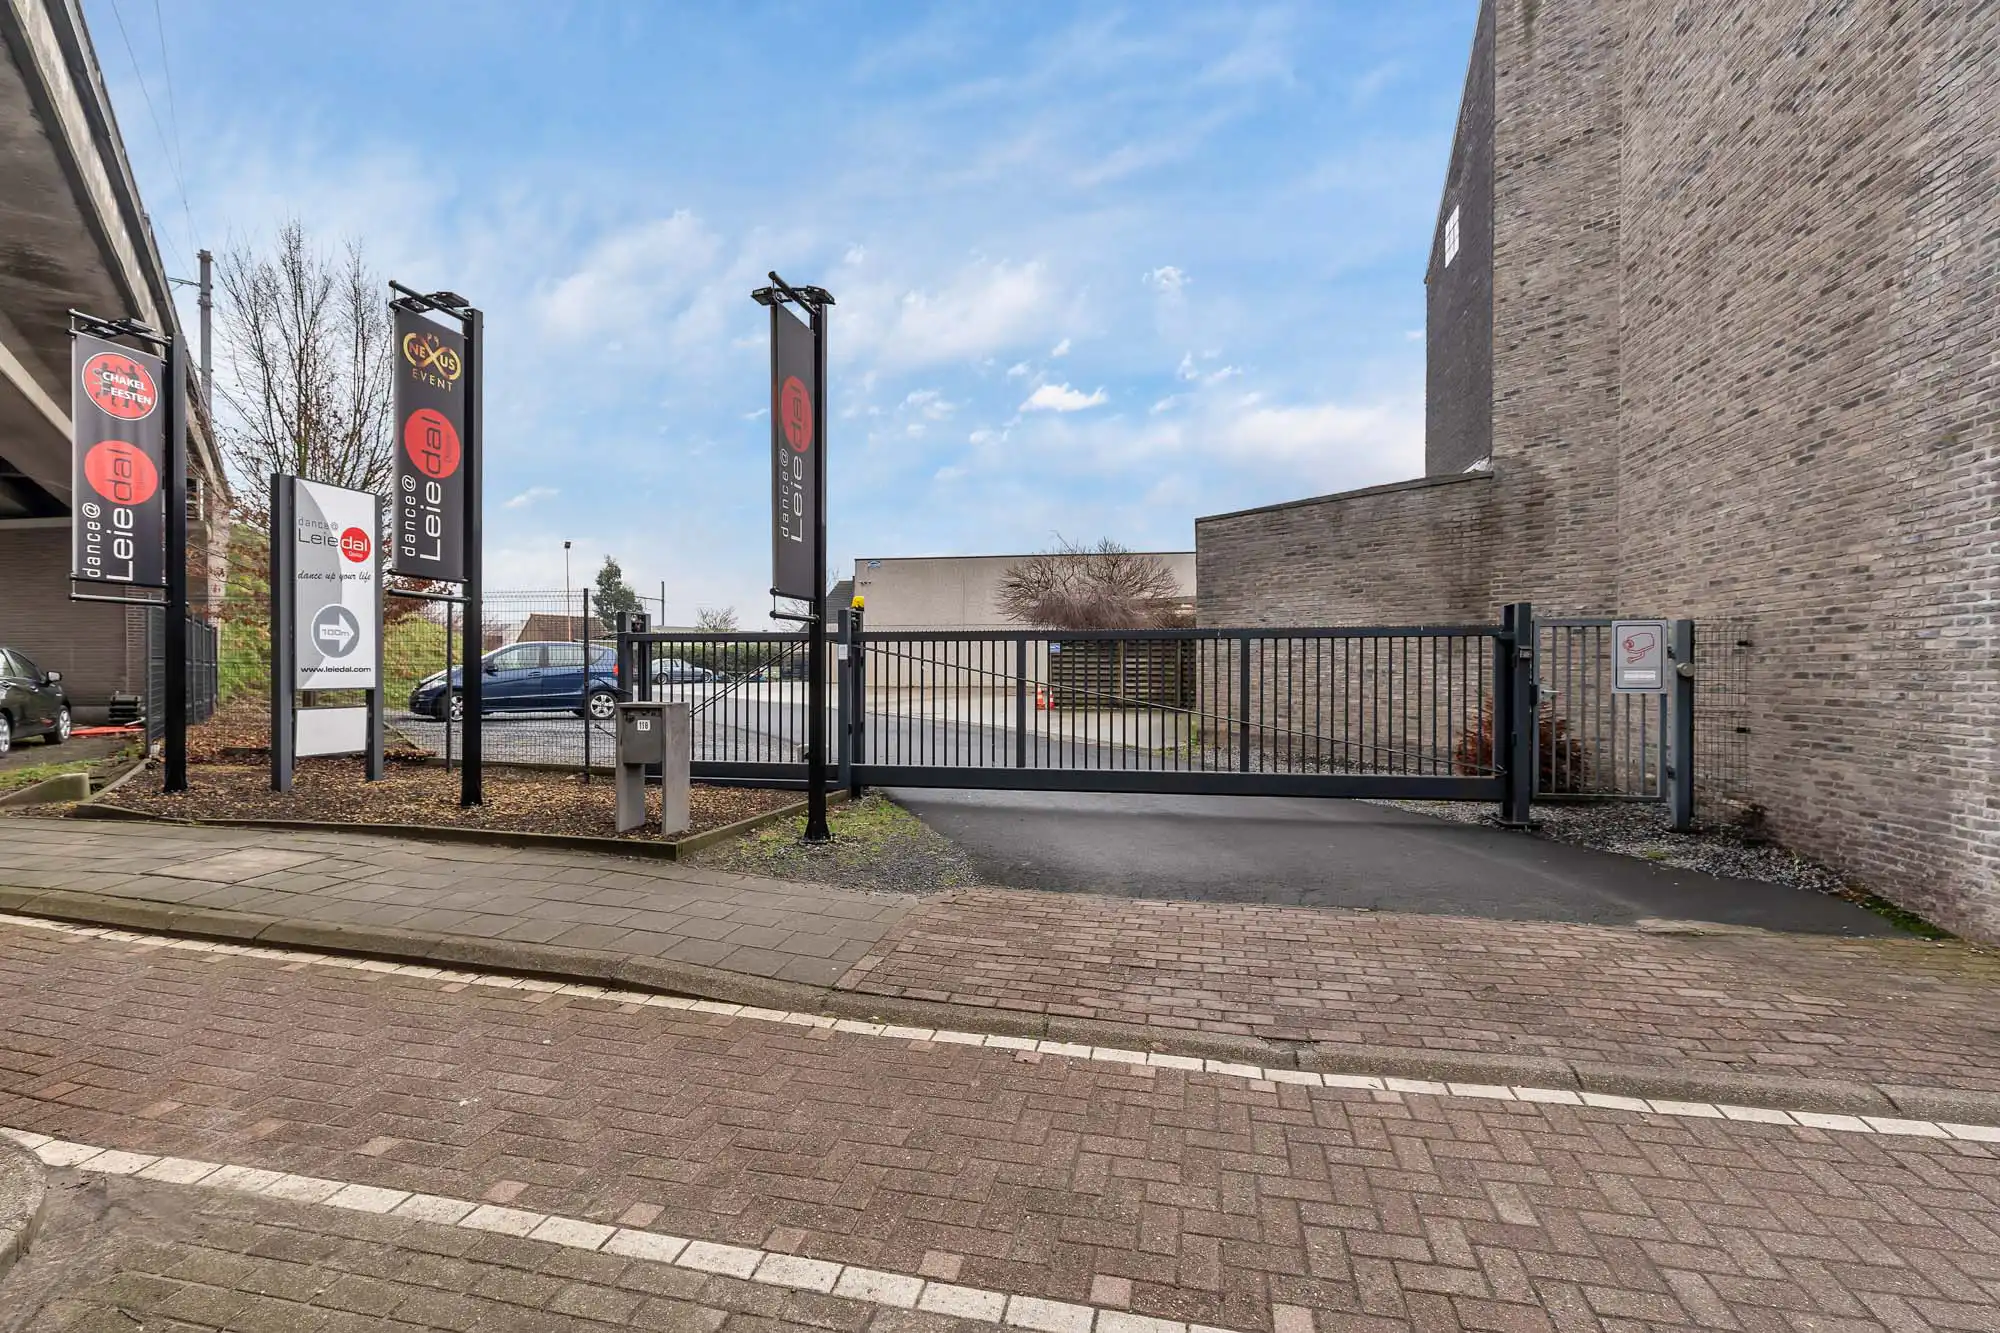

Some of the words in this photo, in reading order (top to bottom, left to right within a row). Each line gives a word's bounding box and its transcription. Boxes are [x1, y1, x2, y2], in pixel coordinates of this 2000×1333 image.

[412, 368, 453, 392] EVENT
[401, 474, 416, 557] dance@
[780, 448, 790, 537] dance@
[82, 502, 101, 578] dance@
[297, 570, 323, 580] dance
[325, 572, 336, 582] up
[339, 573, 356, 582] your
[358, 571, 371, 583] life
[321, 628, 350, 637] 100m
